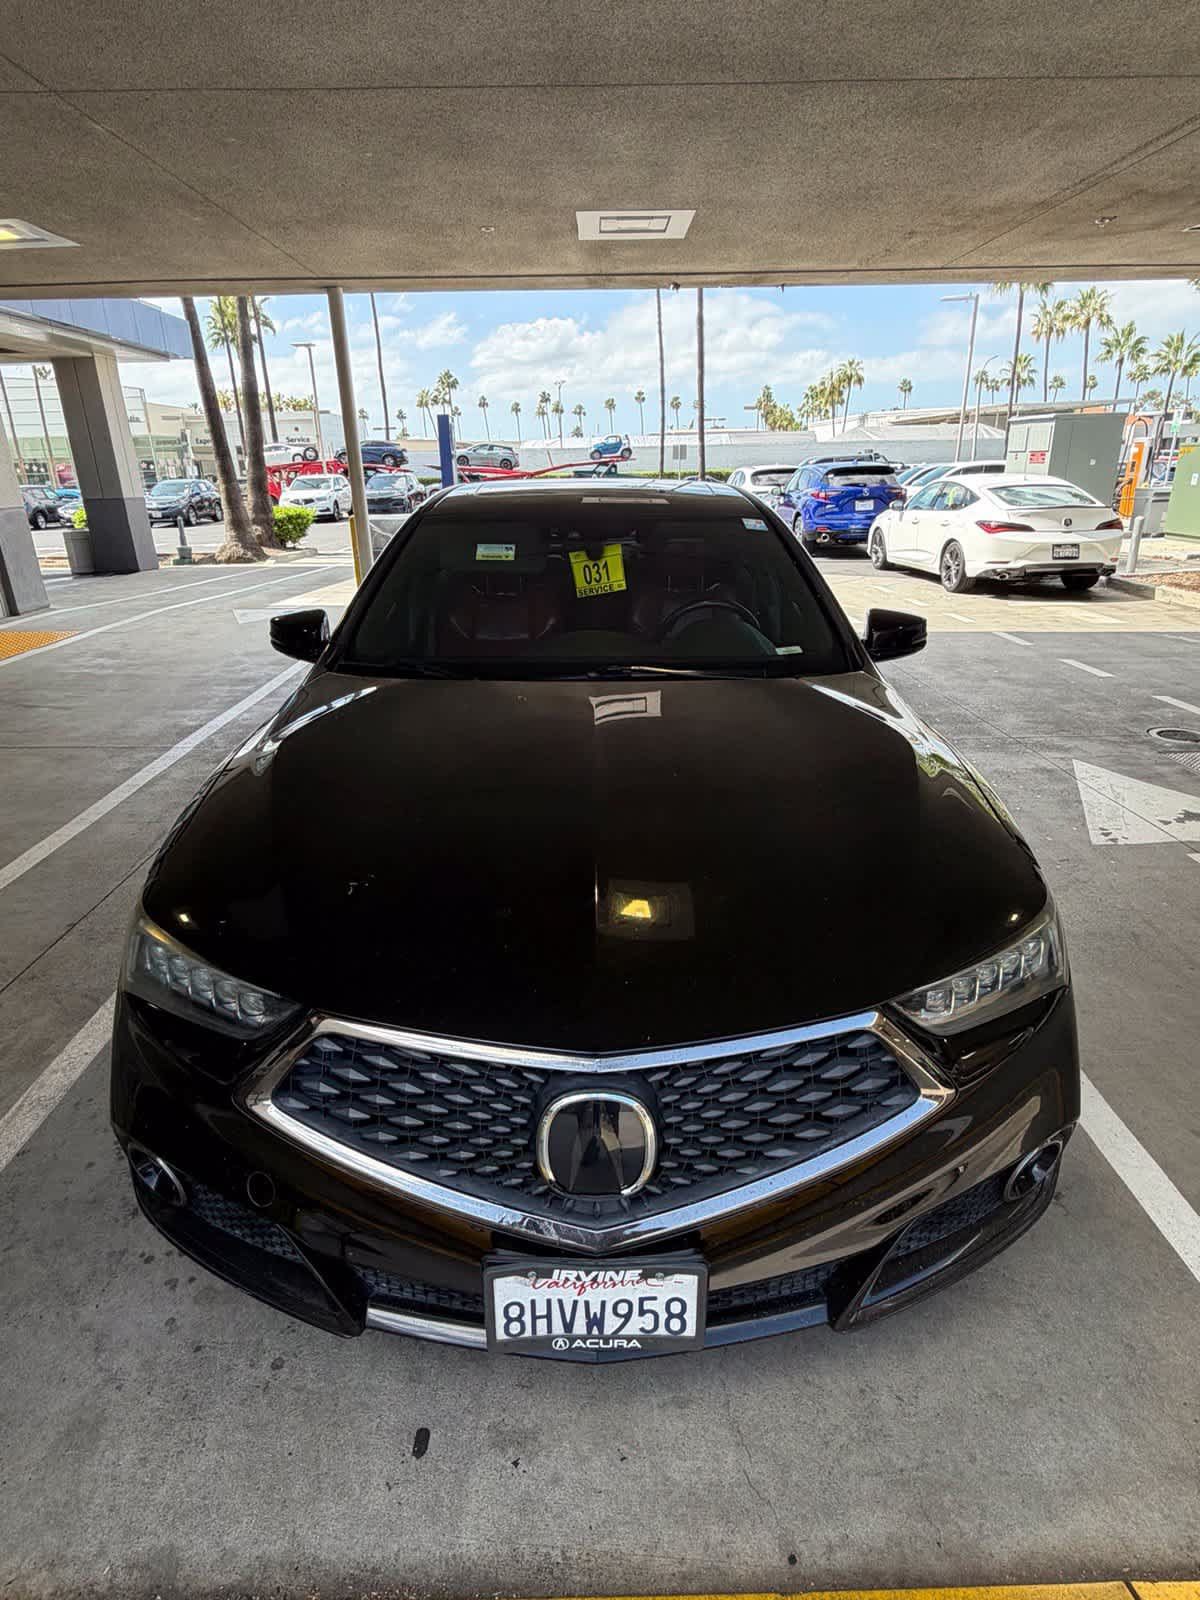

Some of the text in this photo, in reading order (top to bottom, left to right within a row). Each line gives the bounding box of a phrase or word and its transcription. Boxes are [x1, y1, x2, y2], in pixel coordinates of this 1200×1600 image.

[583, 560, 610, 585] 031
[578, 583, 614, 596] SERVICE
[551, 1268, 643, 1282] IRVINE
[503, 1295, 688, 1338] 8HVW958
[571, 1338, 642, 1349] ACURA
